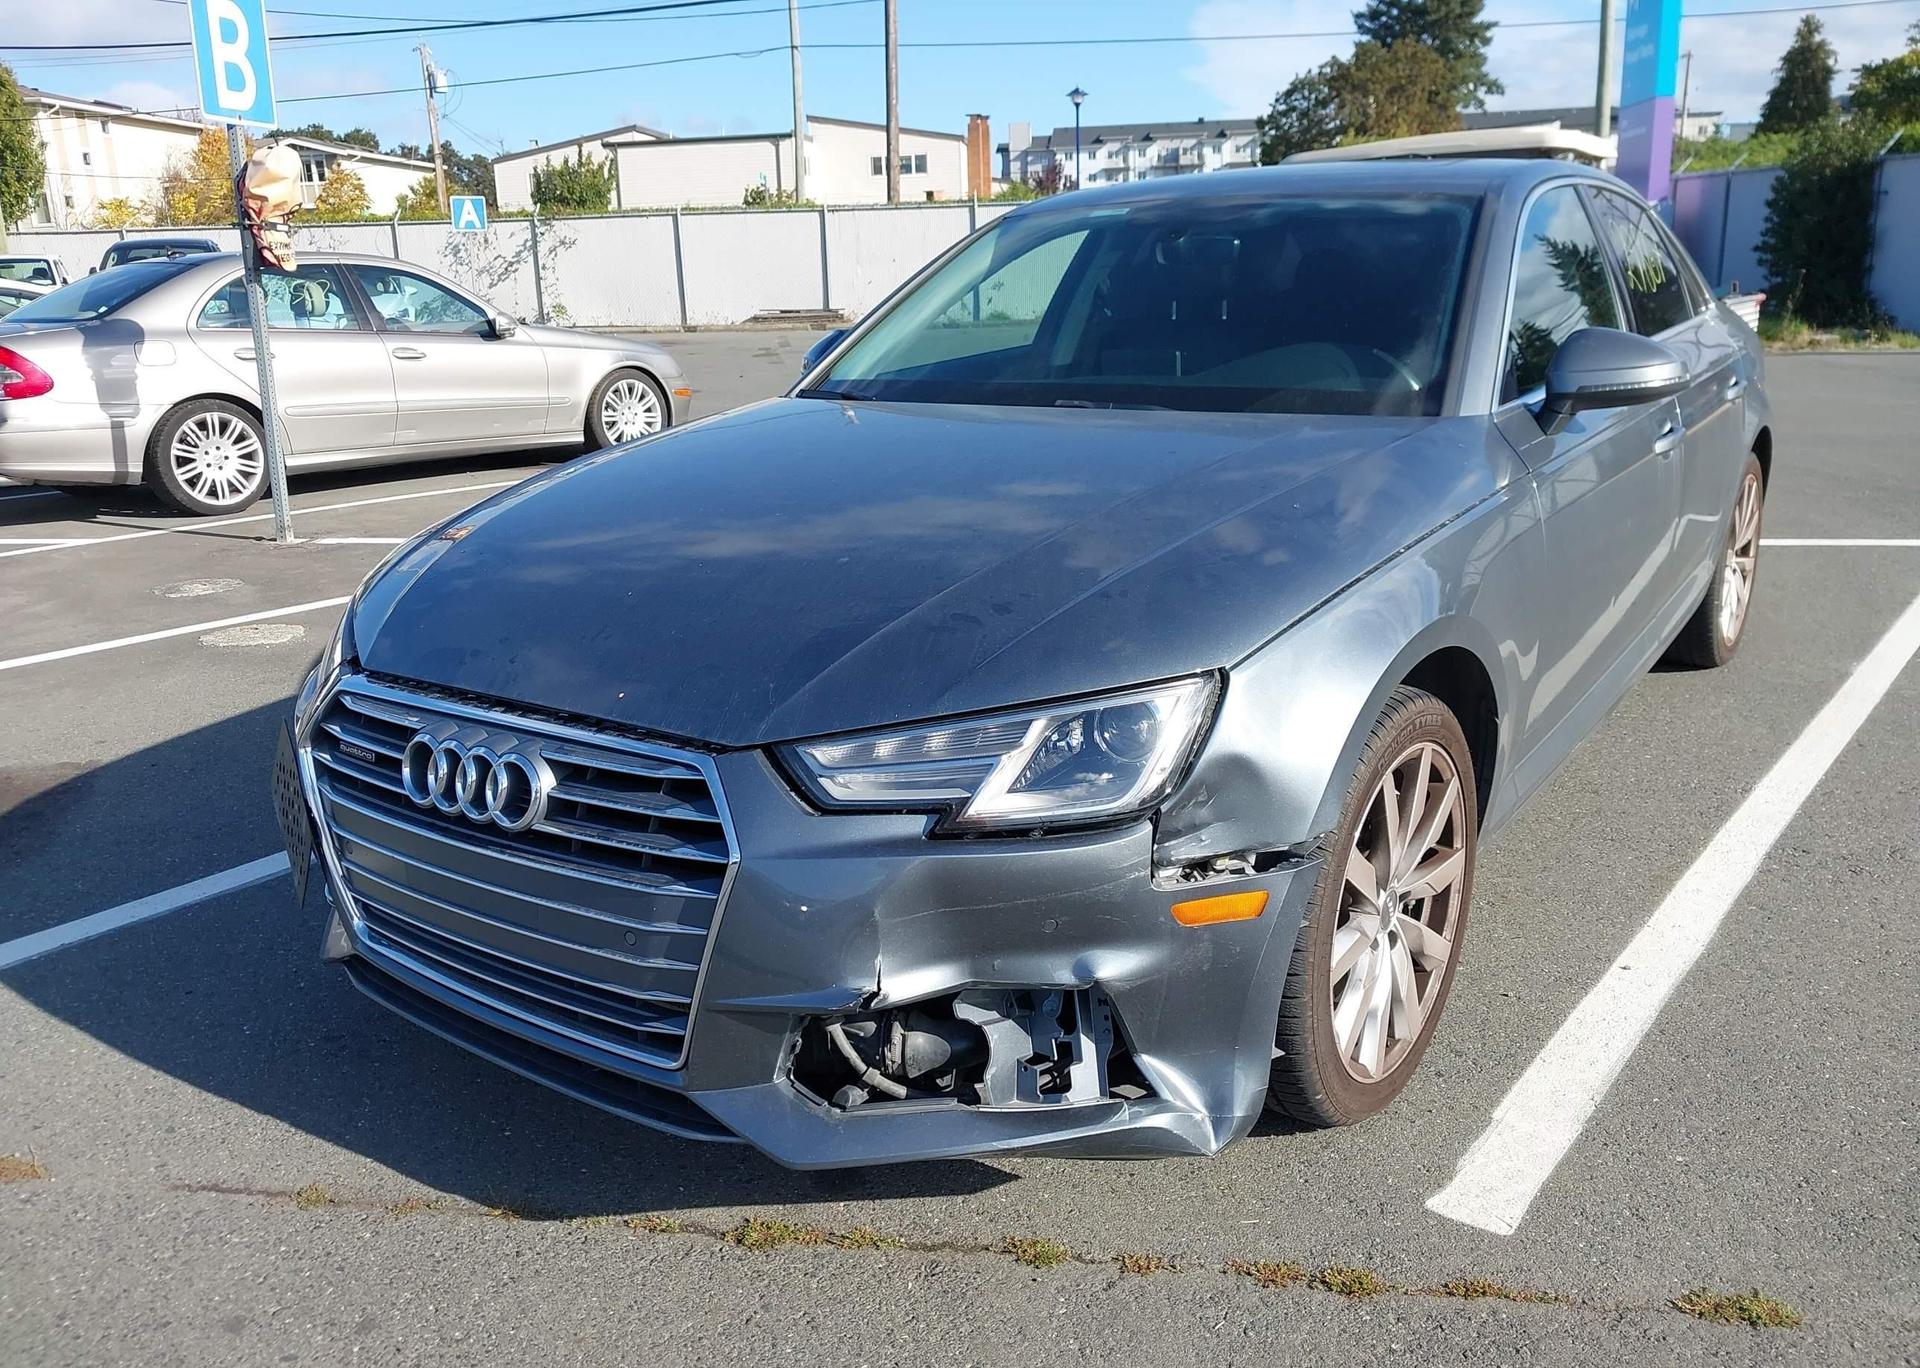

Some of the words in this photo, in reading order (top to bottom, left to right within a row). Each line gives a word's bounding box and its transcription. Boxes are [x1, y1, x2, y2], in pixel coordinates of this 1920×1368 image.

[206, 0, 257, 112] B
[458, 199, 482, 229] A
[340, 744, 372, 760] quattro
